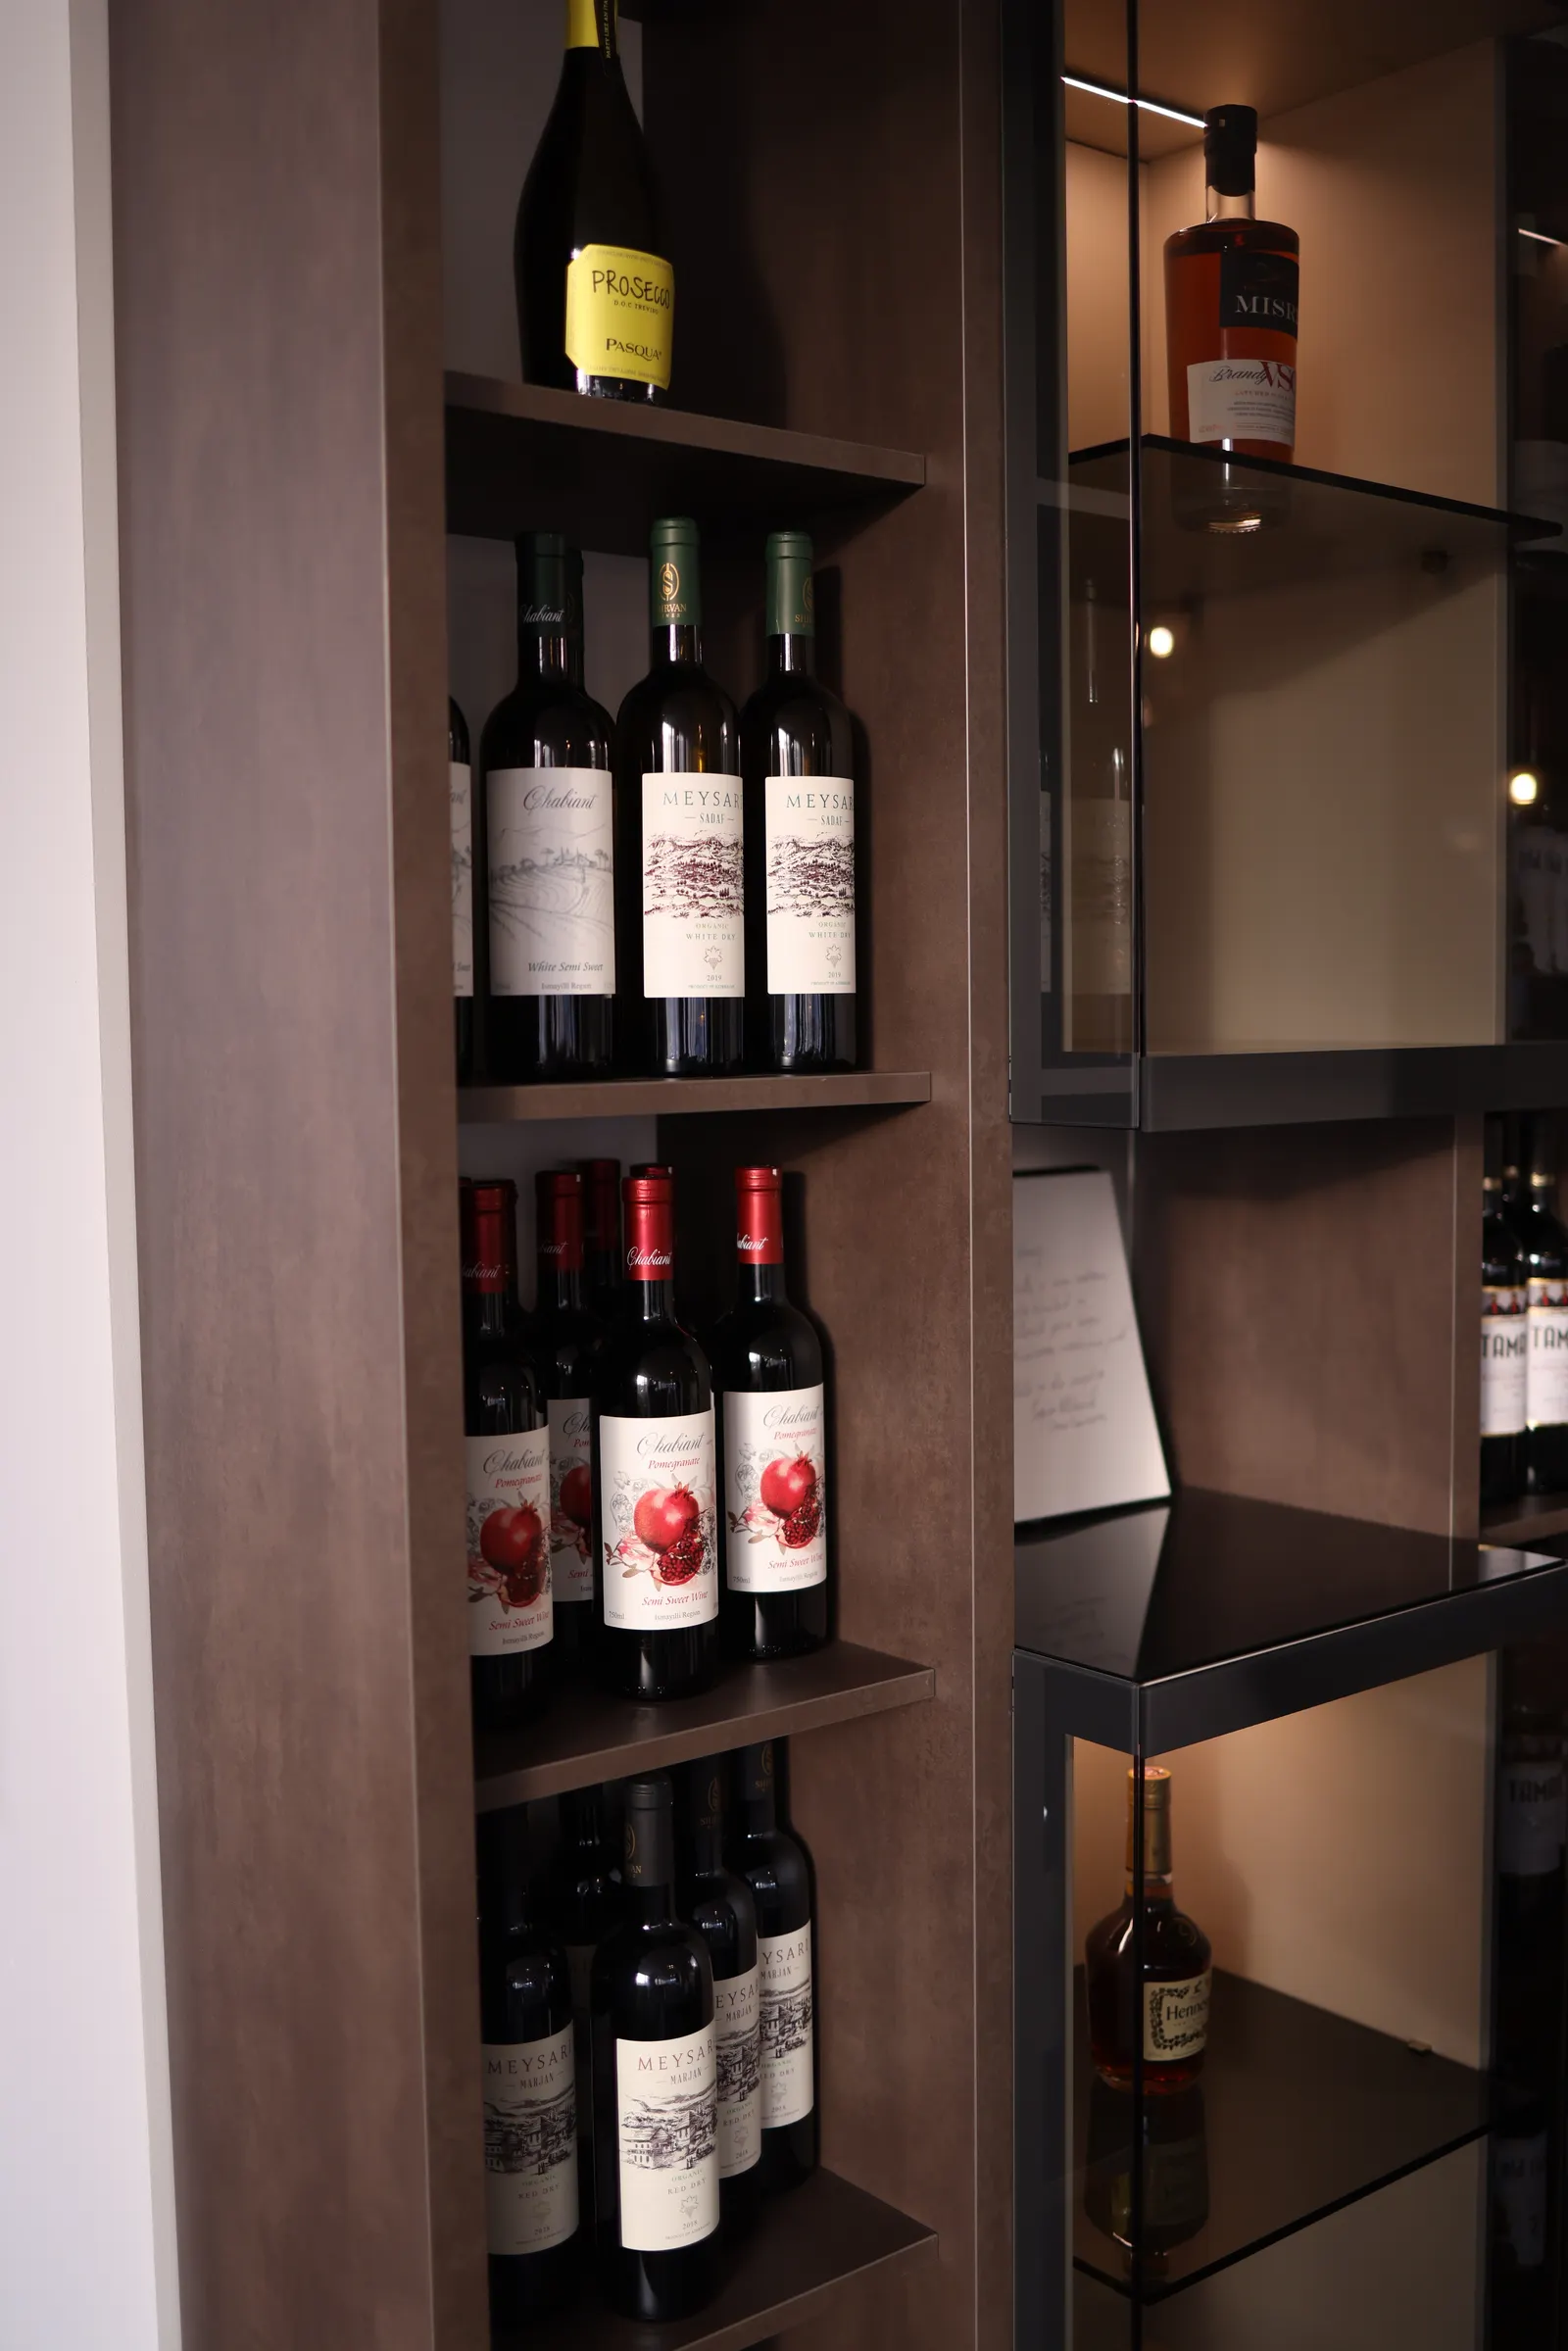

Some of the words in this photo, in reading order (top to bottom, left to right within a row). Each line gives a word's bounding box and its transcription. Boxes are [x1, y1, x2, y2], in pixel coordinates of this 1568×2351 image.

[591, 269, 670, 311] PROSECCO
[1234, 294, 1297, 323] MISR
[1208, 365, 1269, 385] Brandy
[522, 784, 598, 815] Chabiant
[786, 793, 855, 812] MEYSAR
[699, 812, 725, 824] SADAF
[820, 814, 843, 826] SADAF
[527, 960, 558, 973] White
[558, 961, 581, 972] Semi
[583, 961, 604, 972] Sweet
[626, 1246, 672, 1271] Chabiant
[762, 1404, 820, 1430] Chabiant
[636, 1432, 705, 1460] Chabiant
[482, 1448, 546, 1481] Chabiant
[648, 1457, 701, 1472] Pomegranate
[767, 1560, 788, 1569] Semi
[789, 1557, 809, 1568] Sweet
[567, 1568, 590, 1579] Semi
[642, 1596, 663, 1606] Semi
[665, 1594, 690, 1606] Sweet
[691, 1591, 709, 1602] Wine
[488, 1619, 512, 1632] Semi
[513, 1616, 535, 1629] Sweet
[609, 1610, 625, 1620] 750ml
[761, 1937, 808, 1966] YSARI
[760, 1966, 792, 1981] MARJAN
[726, 2004, 753, 2022] MARJAN
[487, 2038, 571, 2075] MEYSARI
[638, 2038, 714, 2072] MEYSAR
[669, 2067, 703, 2084] MARJAN
[667, 2185, 686, 2195] RED
[690, 2177, 707, 2189] DRY
